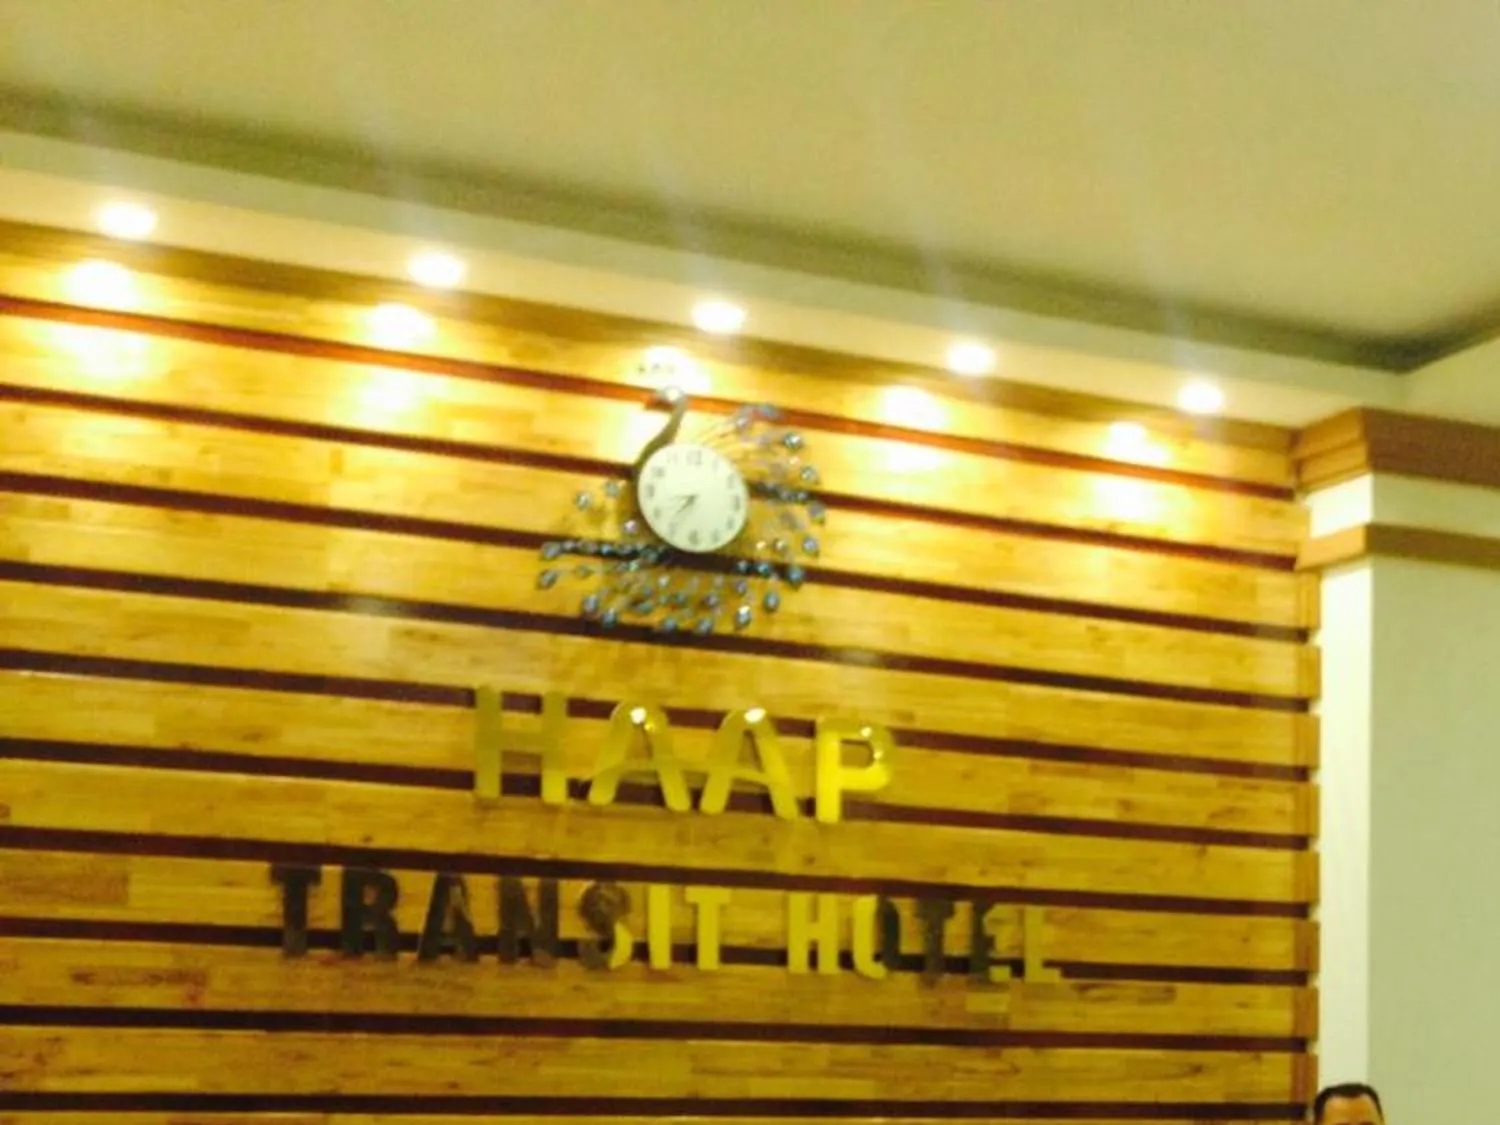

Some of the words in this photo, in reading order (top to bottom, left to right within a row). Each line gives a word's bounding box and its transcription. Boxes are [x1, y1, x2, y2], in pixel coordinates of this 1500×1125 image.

[474, 685, 896, 824] HAAP
[269, 864, 731, 971] TRANSIT
[786, 889, 1062, 985] HOTEL
